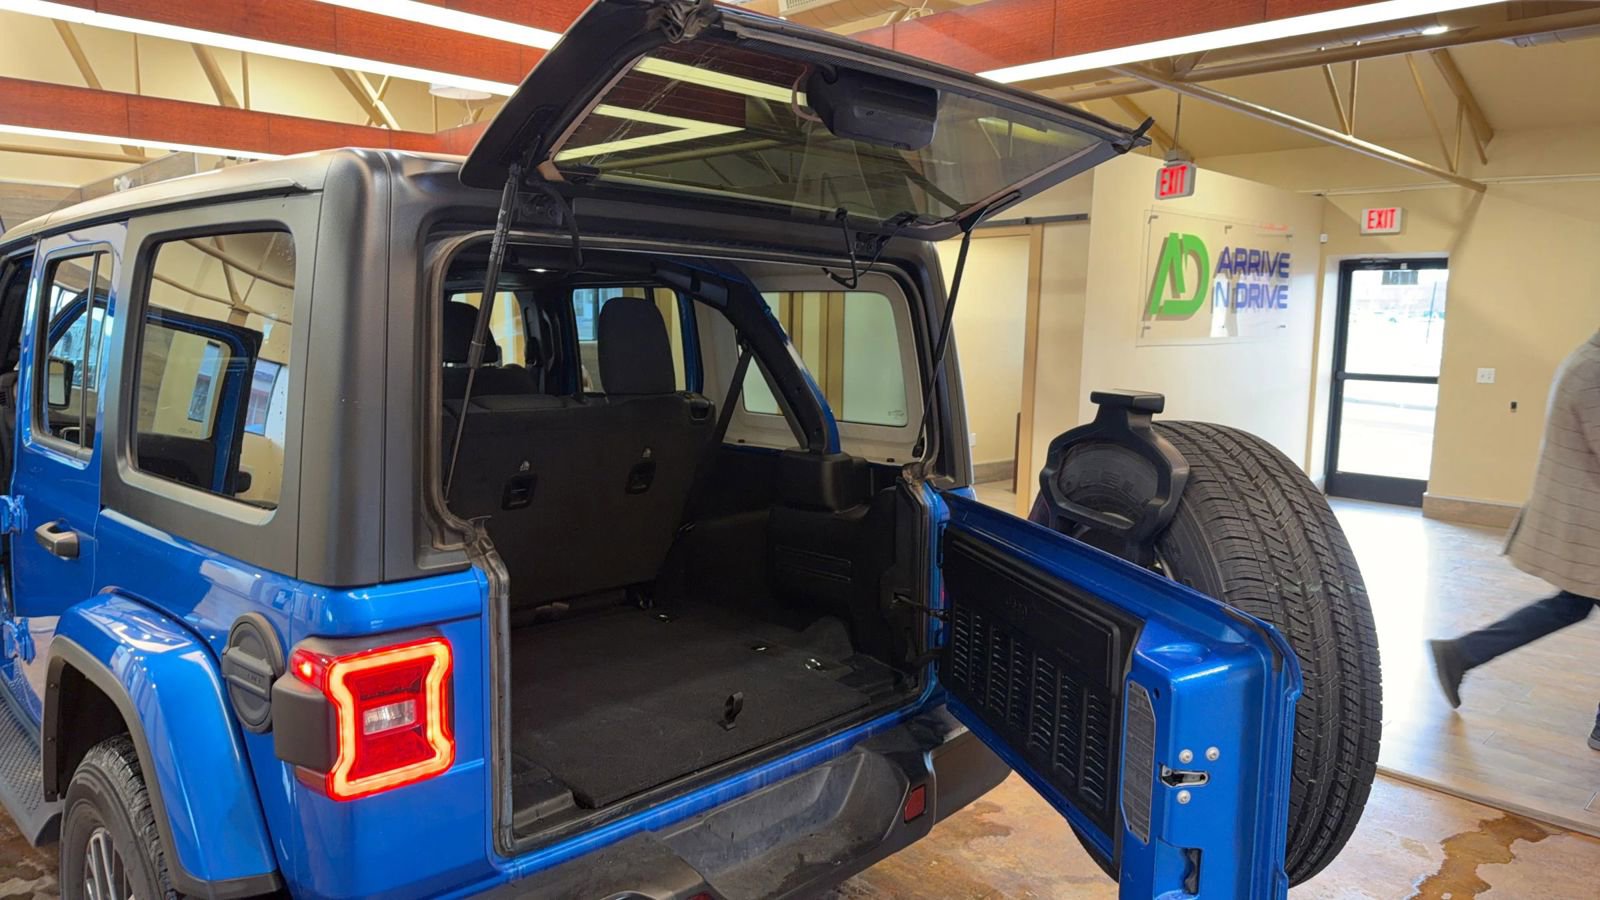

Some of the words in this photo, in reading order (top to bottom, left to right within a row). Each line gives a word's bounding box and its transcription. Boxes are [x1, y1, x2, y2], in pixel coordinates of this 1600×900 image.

[1160, 165, 1187, 196] EXIT
[1367, 208, 1395, 229] EXIT
[1216, 246, 1290, 278] ARRIVE
[1235, 282, 1288, 308] DRIVE
